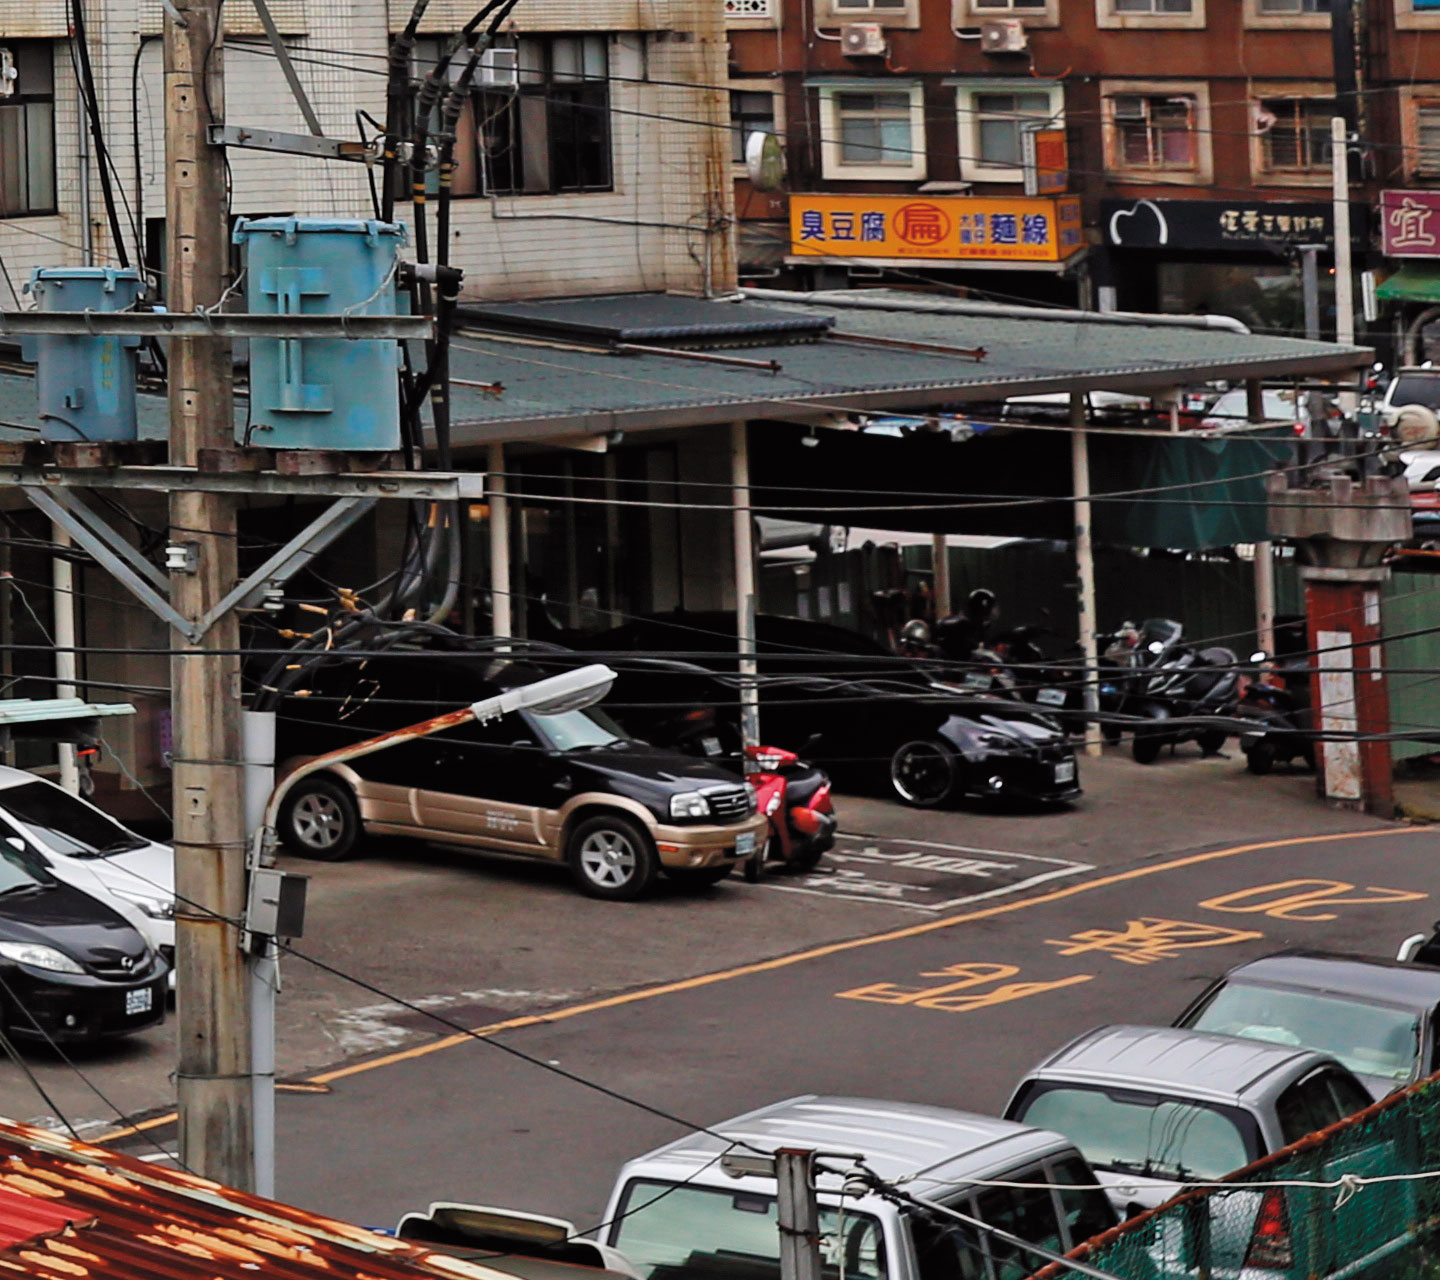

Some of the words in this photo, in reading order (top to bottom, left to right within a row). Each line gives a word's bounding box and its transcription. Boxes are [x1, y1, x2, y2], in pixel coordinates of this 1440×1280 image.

[801, 210, 886, 242] 臭豆腐
[990, 213, 1049, 245] 麵線
